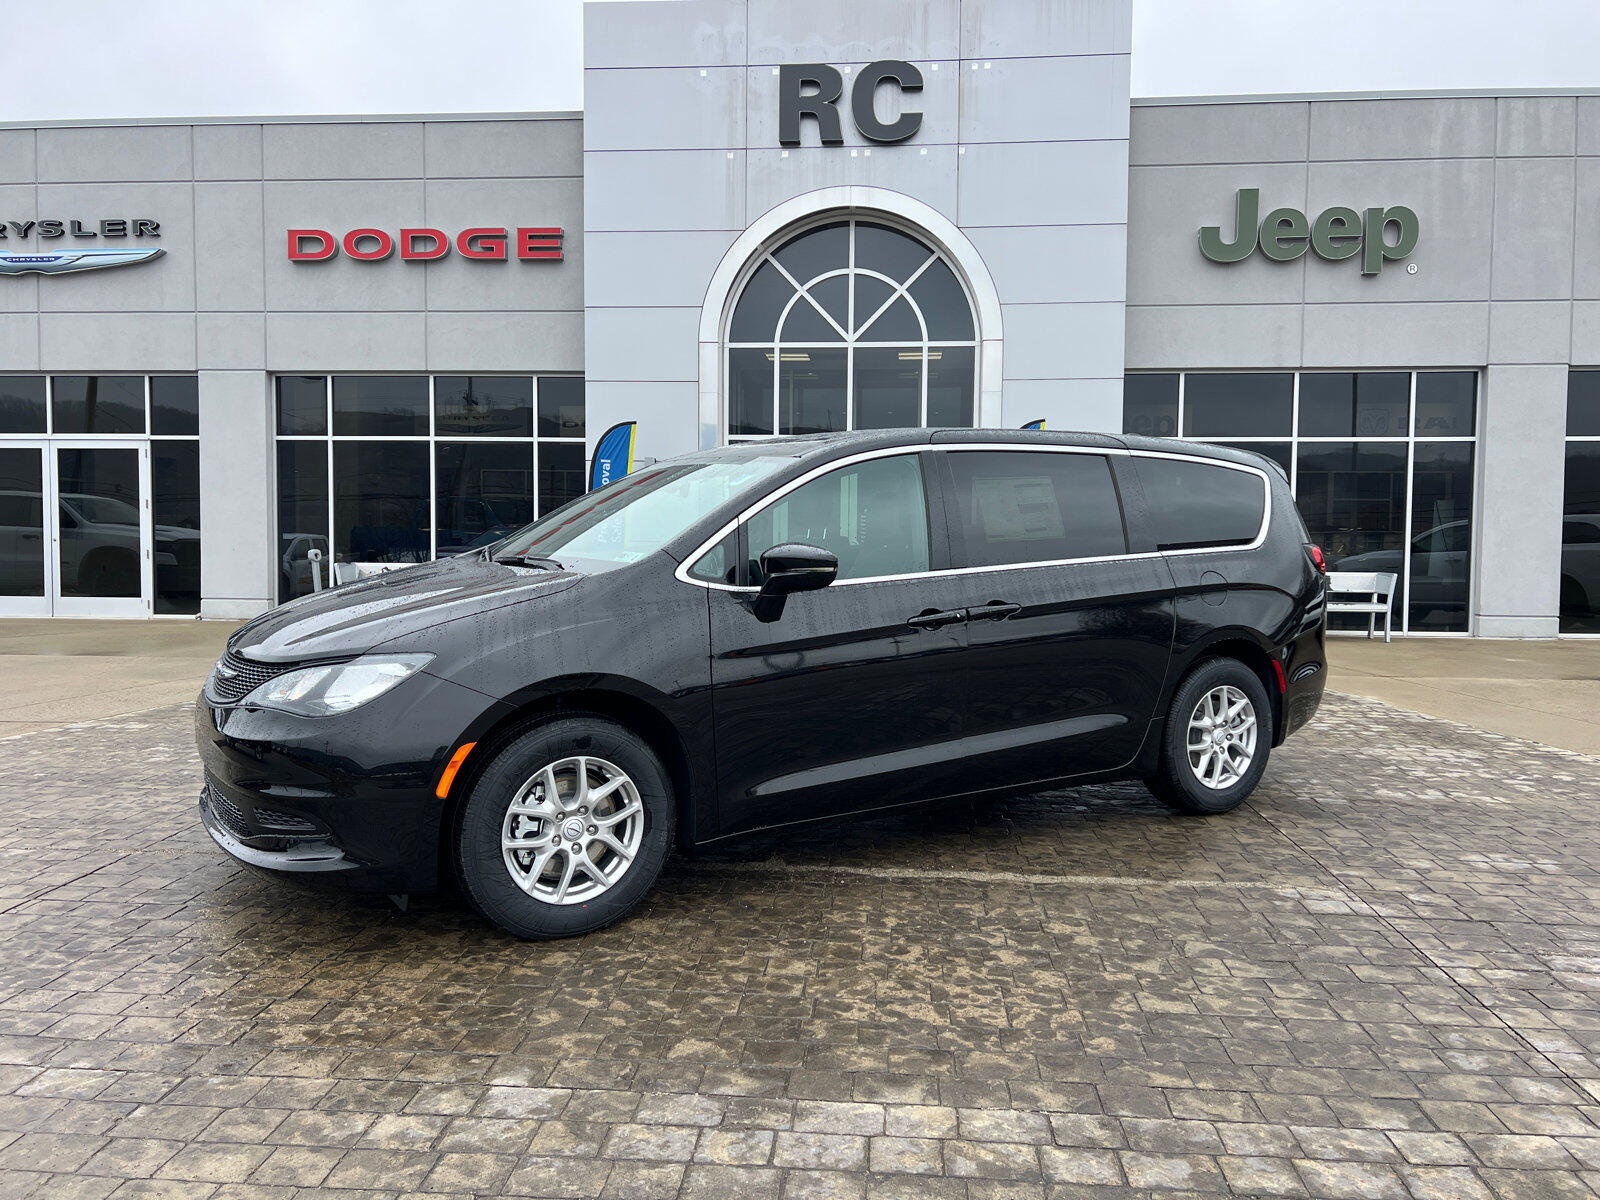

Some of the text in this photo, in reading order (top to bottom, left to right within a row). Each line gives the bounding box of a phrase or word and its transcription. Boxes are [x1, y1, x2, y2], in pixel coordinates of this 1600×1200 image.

[779, 60, 924, 146] RC
[0, 219, 160, 238] YSLER
[287, 227, 565, 263] DODGE
[1199, 188, 1420, 276] Jeep
